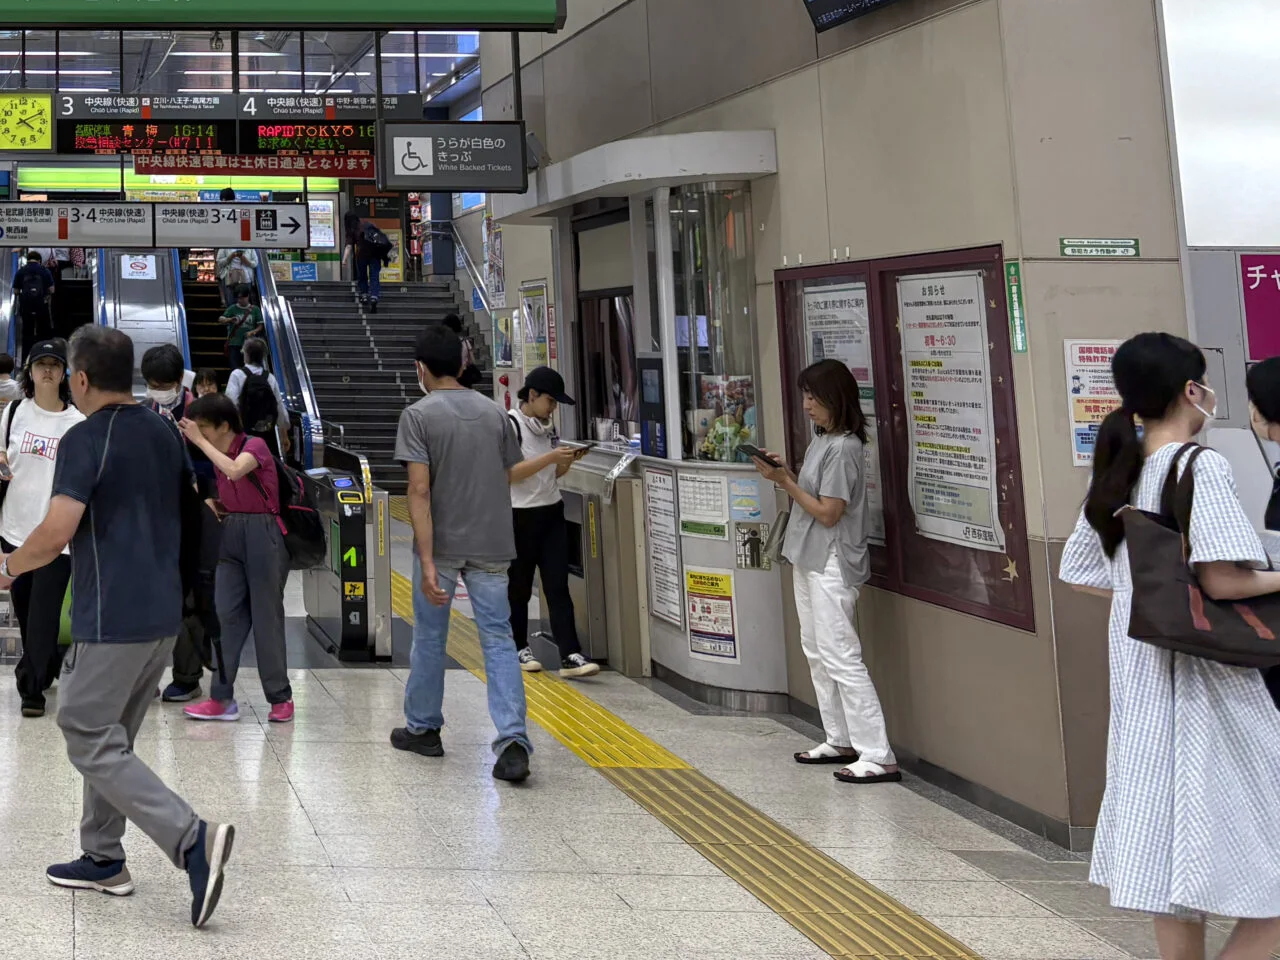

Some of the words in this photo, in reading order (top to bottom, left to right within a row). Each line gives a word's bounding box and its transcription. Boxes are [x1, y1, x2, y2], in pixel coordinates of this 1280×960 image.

[61, 96, 74, 115] 3
[243, 97, 257, 115] 4
[174, 125, 214, 137] 16:14
[257, 125, 294, 137] RAPID
[436, 137, 506, 149] うらが白色の
[137, 154, 372, 171] 中央線快速電車は土休日通過となります
[437, 151, 472, 162] きっぷ
[459, 164, 486, 172] Backed
[487, 164, 512, 172] Tickets
[922, 285, 945, 296] お知らせ
[1084, 405, 1114, 413] 無償で休
